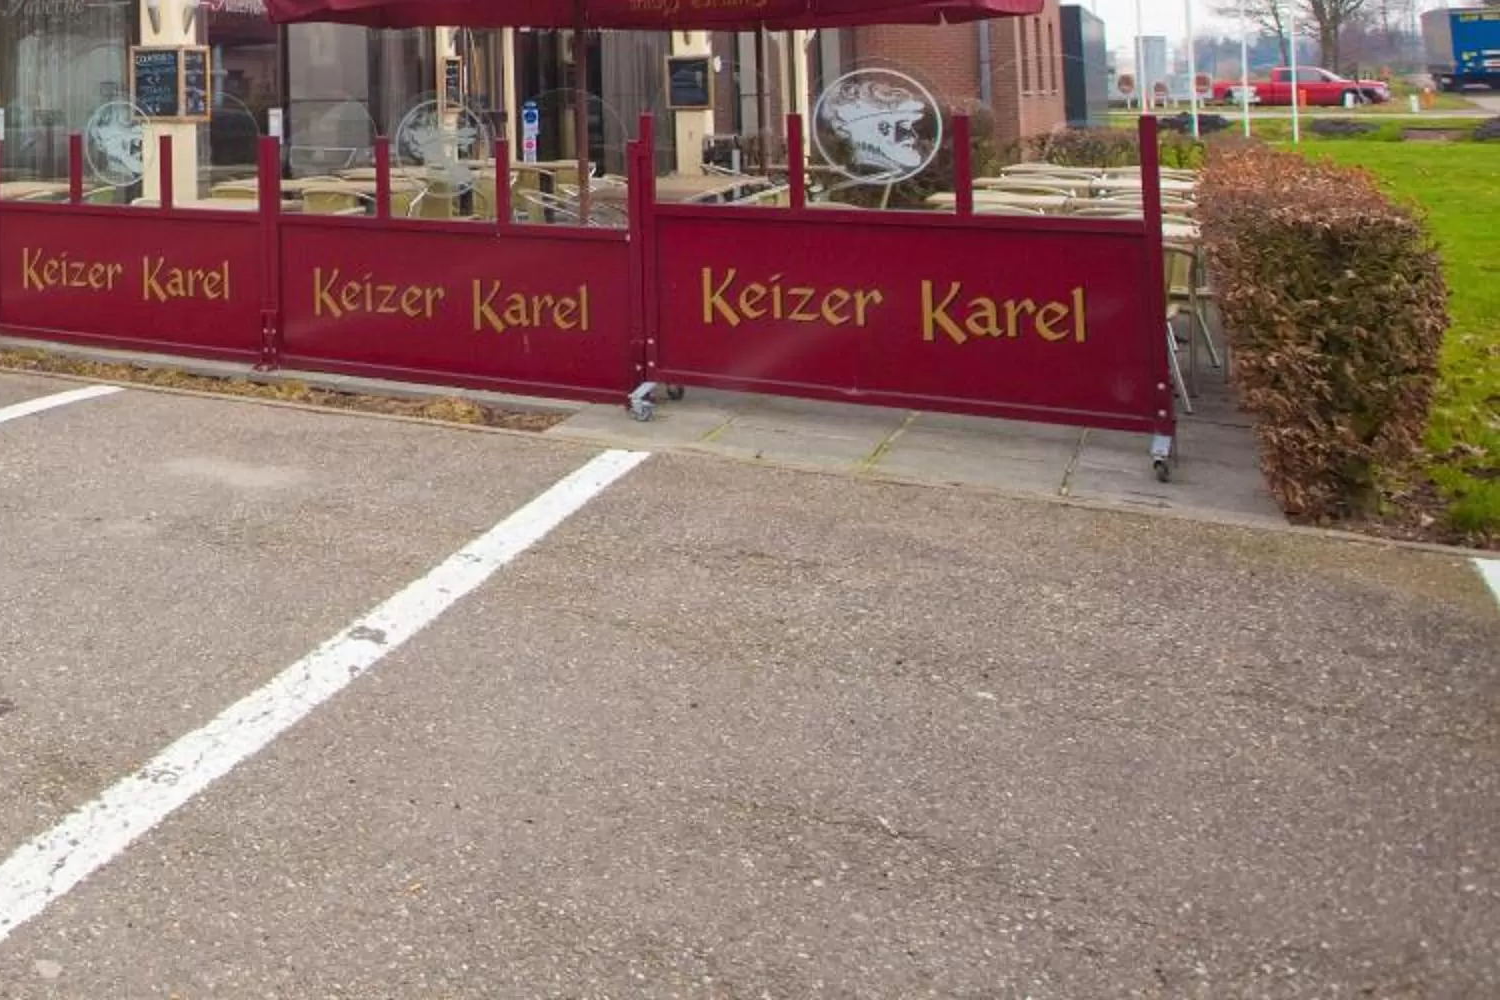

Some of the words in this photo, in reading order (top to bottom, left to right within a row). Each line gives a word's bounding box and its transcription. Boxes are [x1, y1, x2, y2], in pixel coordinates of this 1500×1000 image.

[22, 247, 122, 291] Keizer
[143, 256, 230, 302] Karel
[313, 266, 445, 318] Keizer
[472, 279, 590, 333] Karel
[701, 267, 884, 327] Keizer
[920, 280, 1088, 345] Karel
